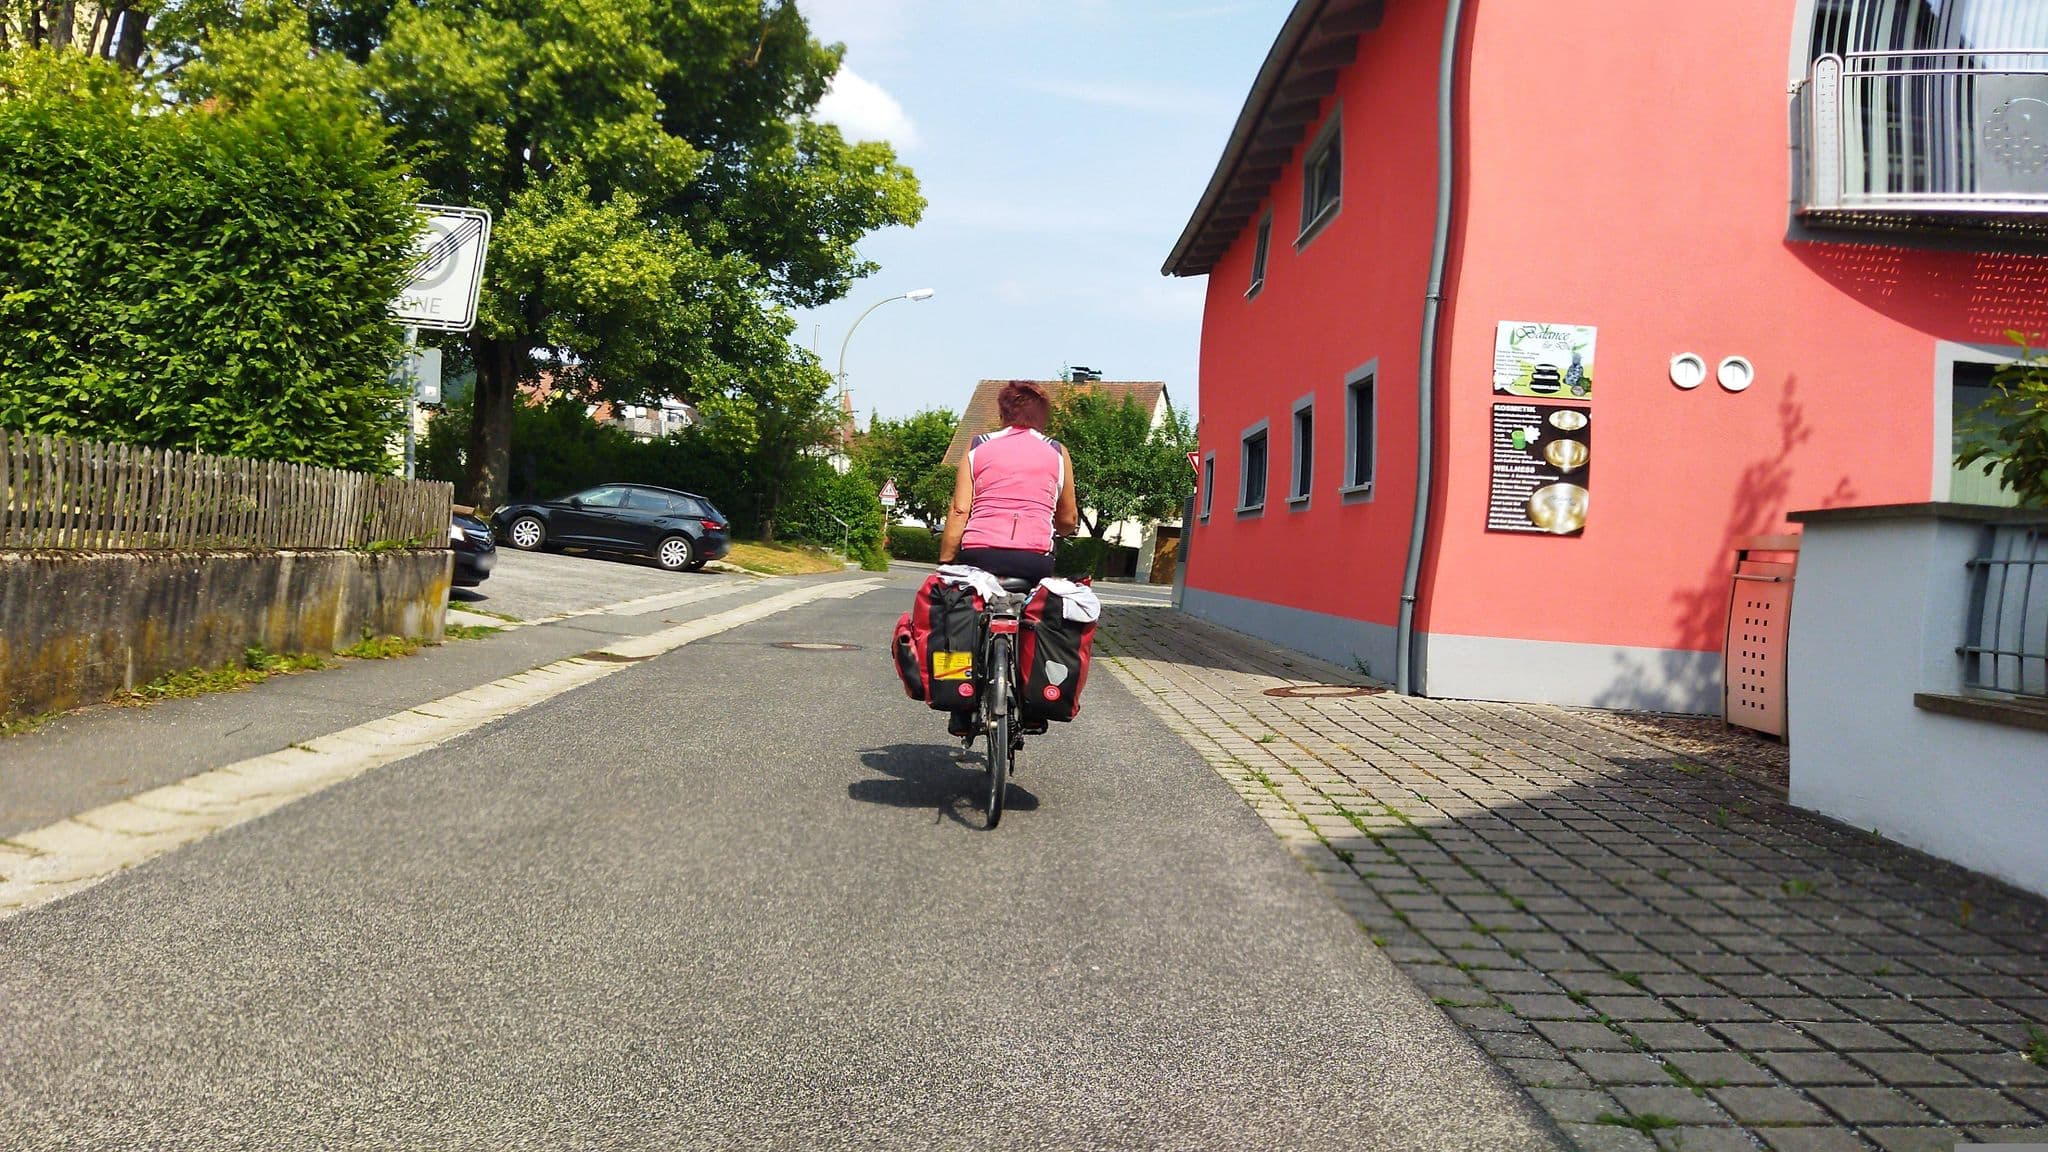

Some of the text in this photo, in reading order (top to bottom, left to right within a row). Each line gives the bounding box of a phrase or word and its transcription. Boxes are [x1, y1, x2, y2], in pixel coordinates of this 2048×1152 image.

[400, 295, 442, 315] ONE
[1516, 325, 1571, 341] Balance
[1494, 404, 1537, 413] KOSMETIK
[1493, 464, 1536, 474] WELLNESS
